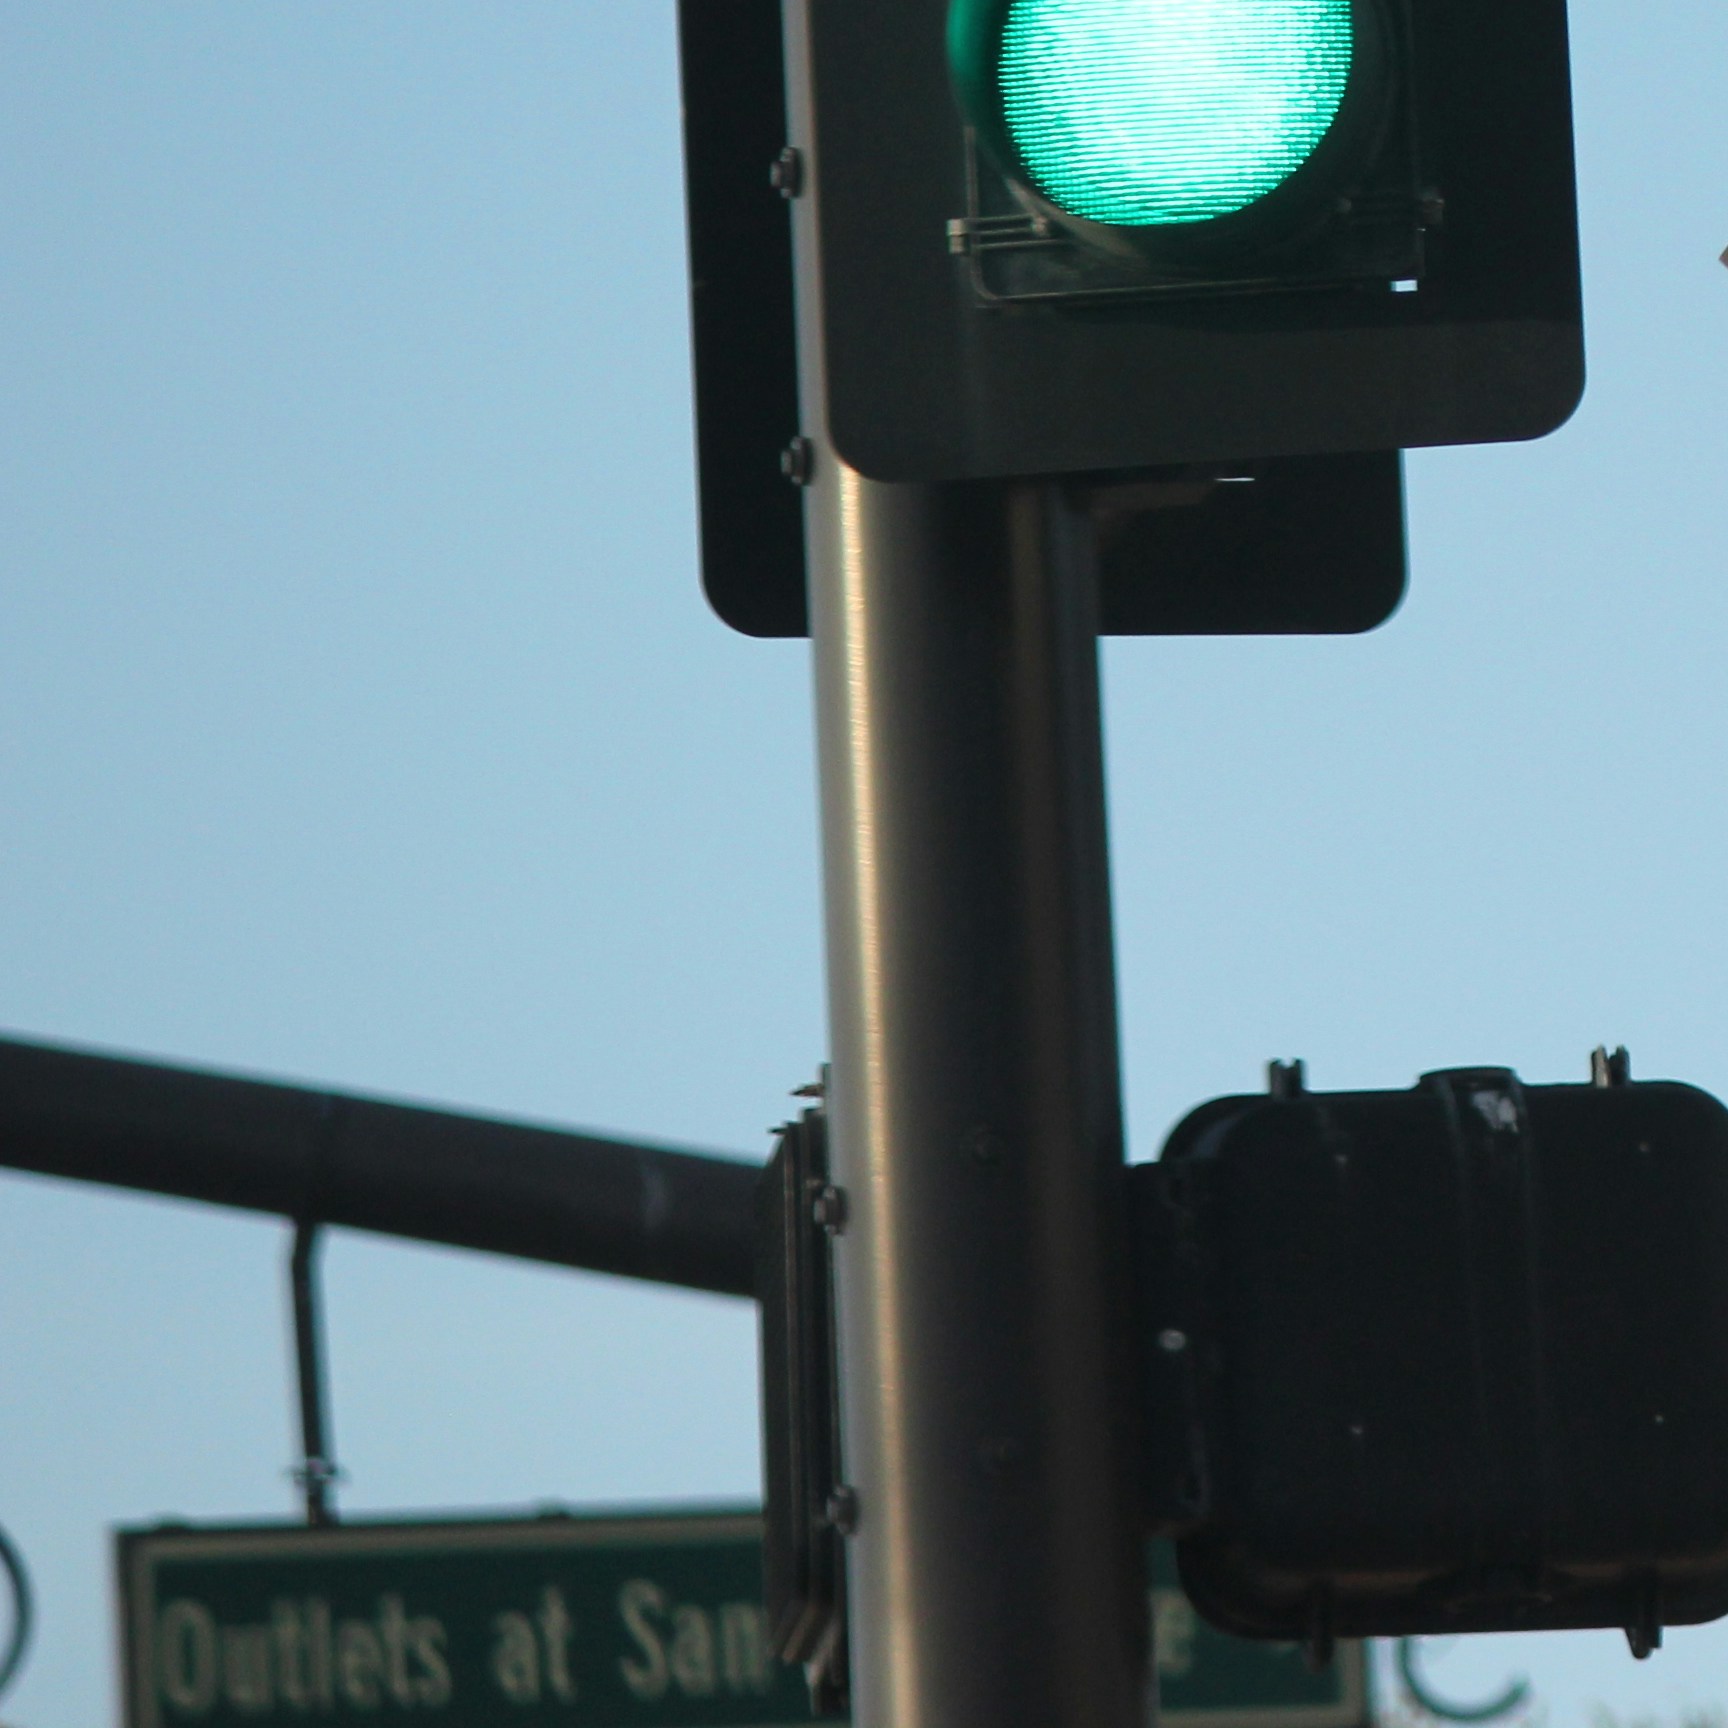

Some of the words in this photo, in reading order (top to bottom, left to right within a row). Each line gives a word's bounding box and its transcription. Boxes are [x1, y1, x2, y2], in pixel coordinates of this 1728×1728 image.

[160, 1594, 451, 1712] Outlets
[493, 1584, 575, 1703] at
[618, 1577, 772, 1700] San
